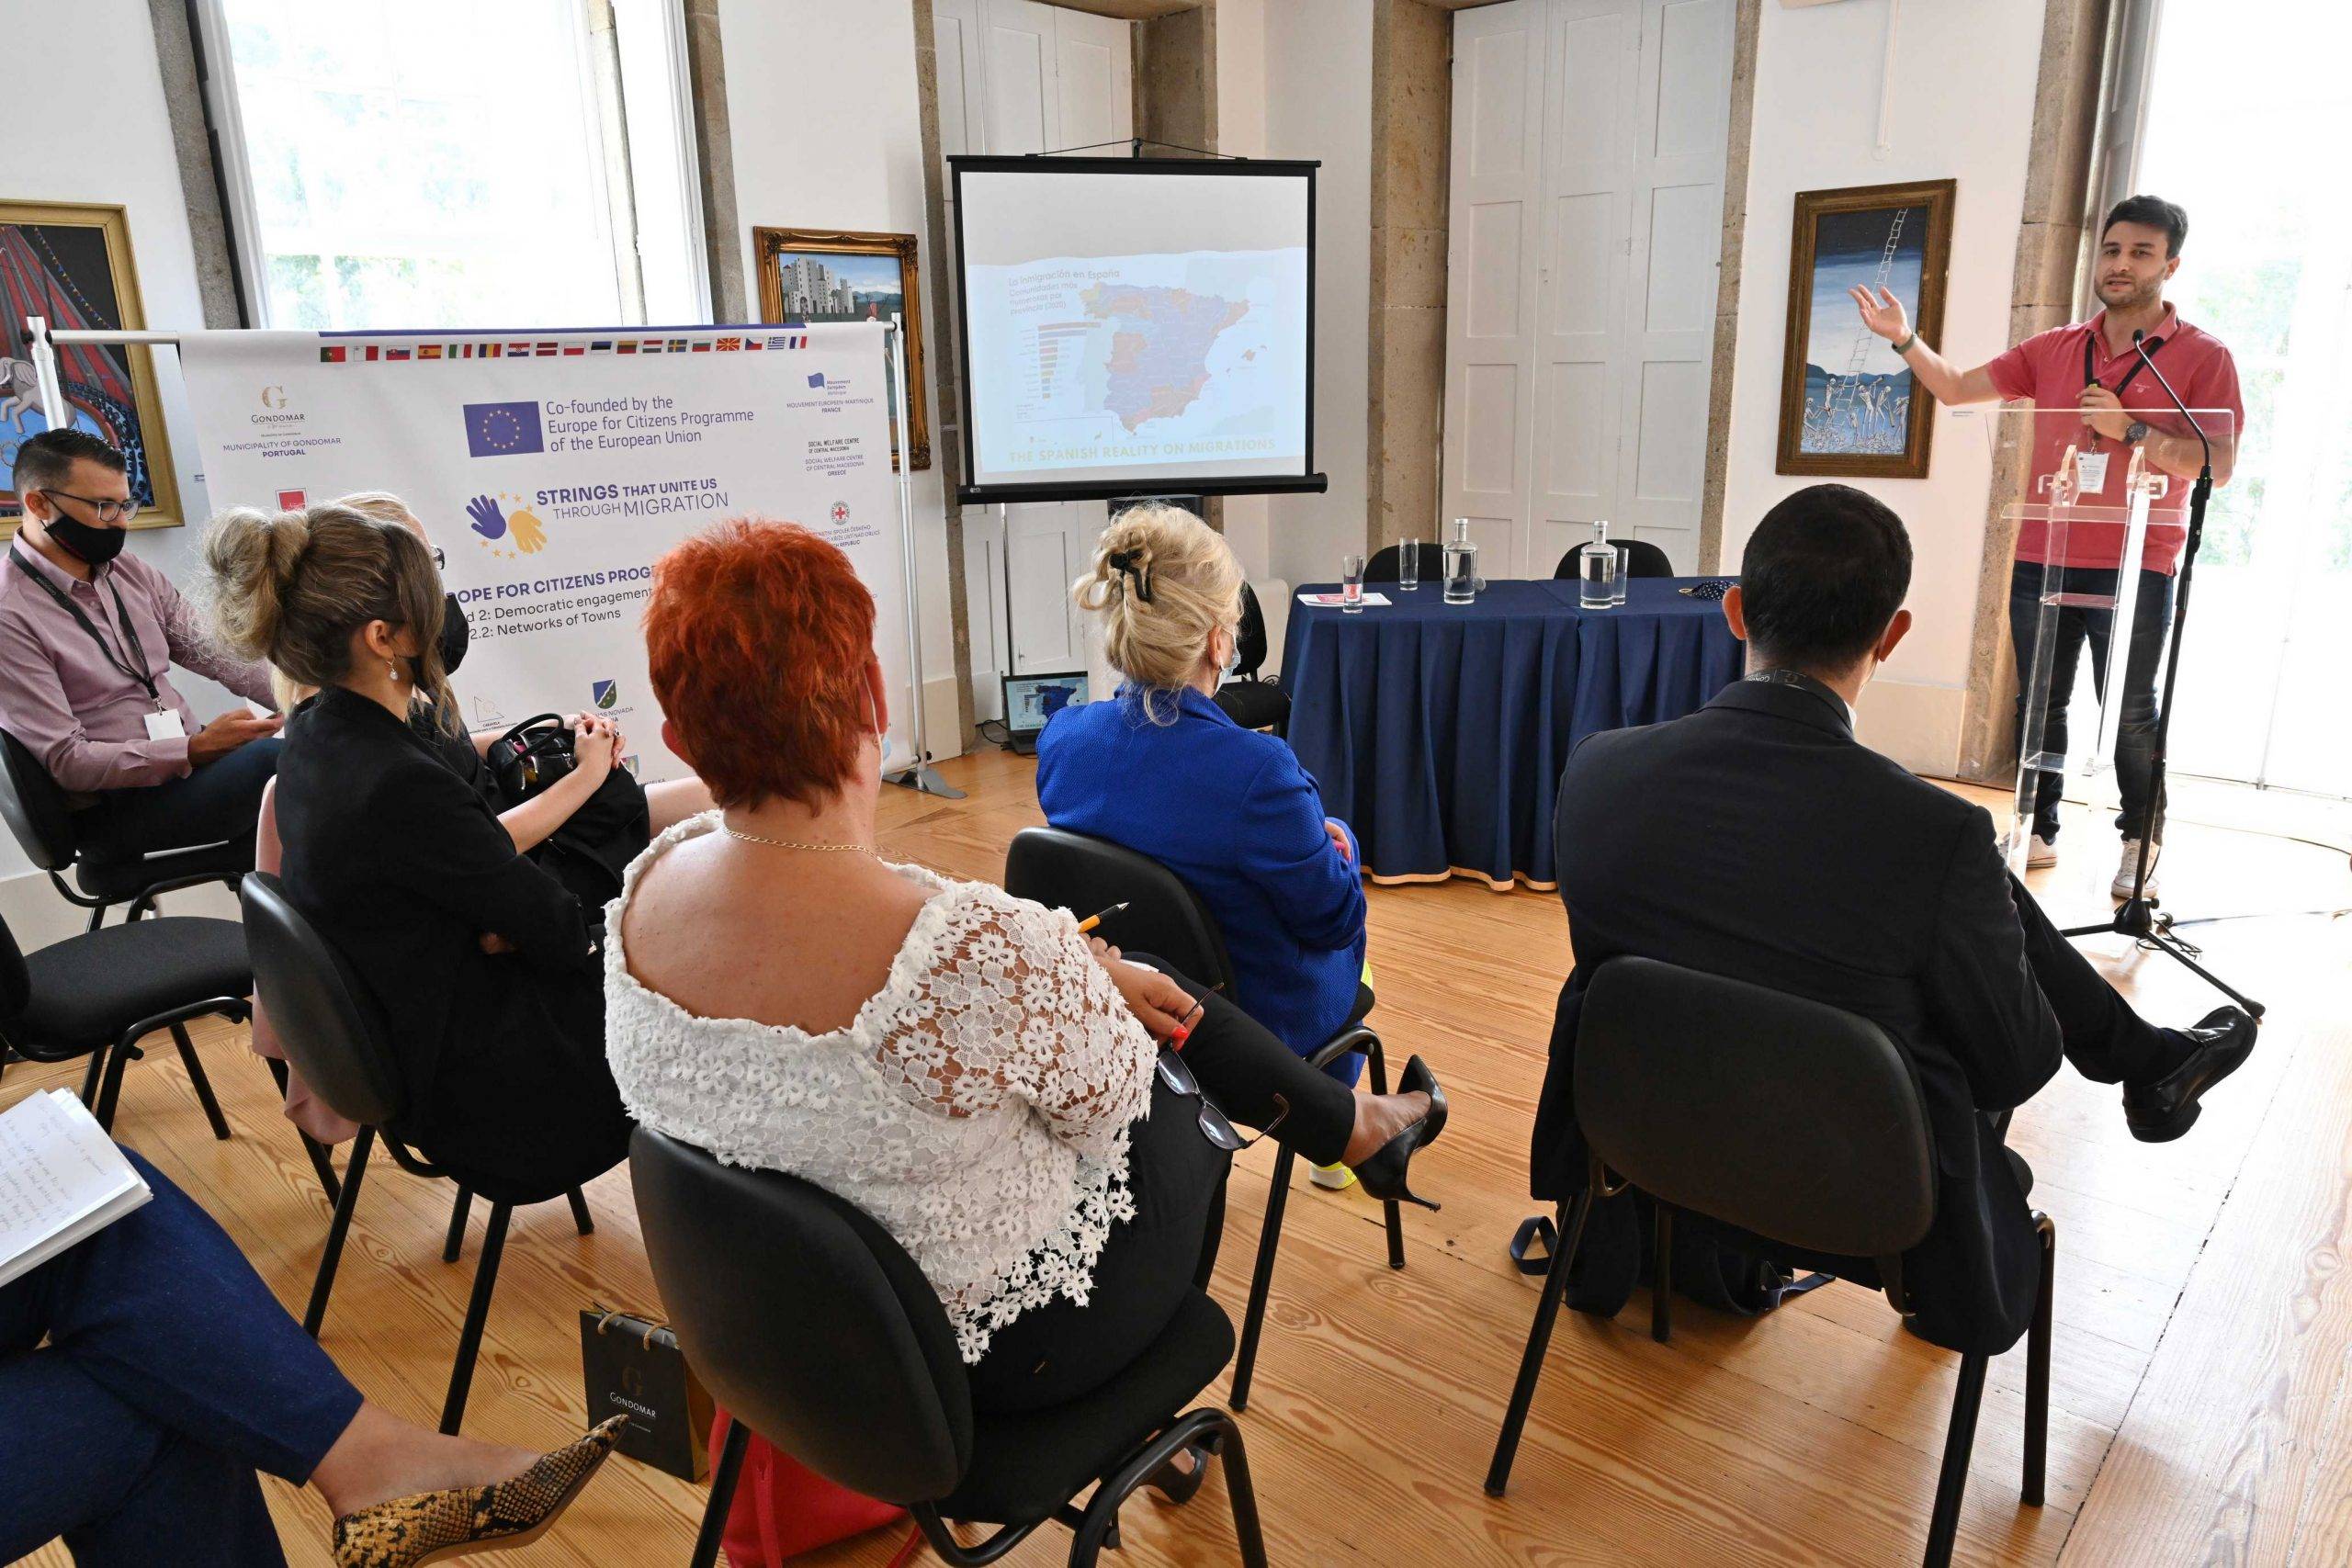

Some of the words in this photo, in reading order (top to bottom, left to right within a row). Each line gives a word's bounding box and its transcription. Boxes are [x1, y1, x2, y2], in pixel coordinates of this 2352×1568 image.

[1088, 269, 1120, 280] España
[262, 386, 288, 409] G
[546, 397, 628, 415] Co-founded
[632, 397, 648, 412] by
[652, 396, 673, 410] the
[251, 413, 306, 423] GONDOMAR
[548, 420, 597, 434] Europe
[603, 416, 622, 430] for
[627, 415, 677, 429] Citizens
[681, 411, 754, 427] Programme
[222, 442, 279, 451] MUNICIPALITY
[293, 437, 342, 447] GONDOMAR
[262, 449, 306, 457] PORTUGAL
[550, 437, 565, 452] of
[571, 436, 594, 450] the
[598, 434, 662, 450] European
[665, 431, 702, 444] Union
[1010, 450, 1033, 463] THE
[1038, 447, 1098, 461] SPANISH
[1102, 444, 1158, 458] REALITY
[1163, 442, 1184, 455] ON
[1188, 438, 1276, 453] MIGRATIONS
[537, 484, 619, 506] STRINGS
[623, 483, 657, 497] THAT
[659, 479, 697, 494] UNITE
[699, 478, 718, 490] US
[553, 502, 621, 520] THROUGH
[624, 491, 729, 517] MIGRATION
[447, 587, 492, 604] OPE
[496, 582, 530, 599] FOR
[534, 572, 605, 594] CITIZENS
[608, 565, 655, 583] PROG
[479, 609, 491, 621] 2:
[494, 598, 573, 619] Democratic
[576, 587, 653, 608] engagement
[470, 626, 493, 640] 2.2:
[497, 618, 563, 636] Networks
[566, 613, 579, 626] of
[581, 609, 621, 624] Towns
[609, 1392, 656, 1418] GONDOMAR
